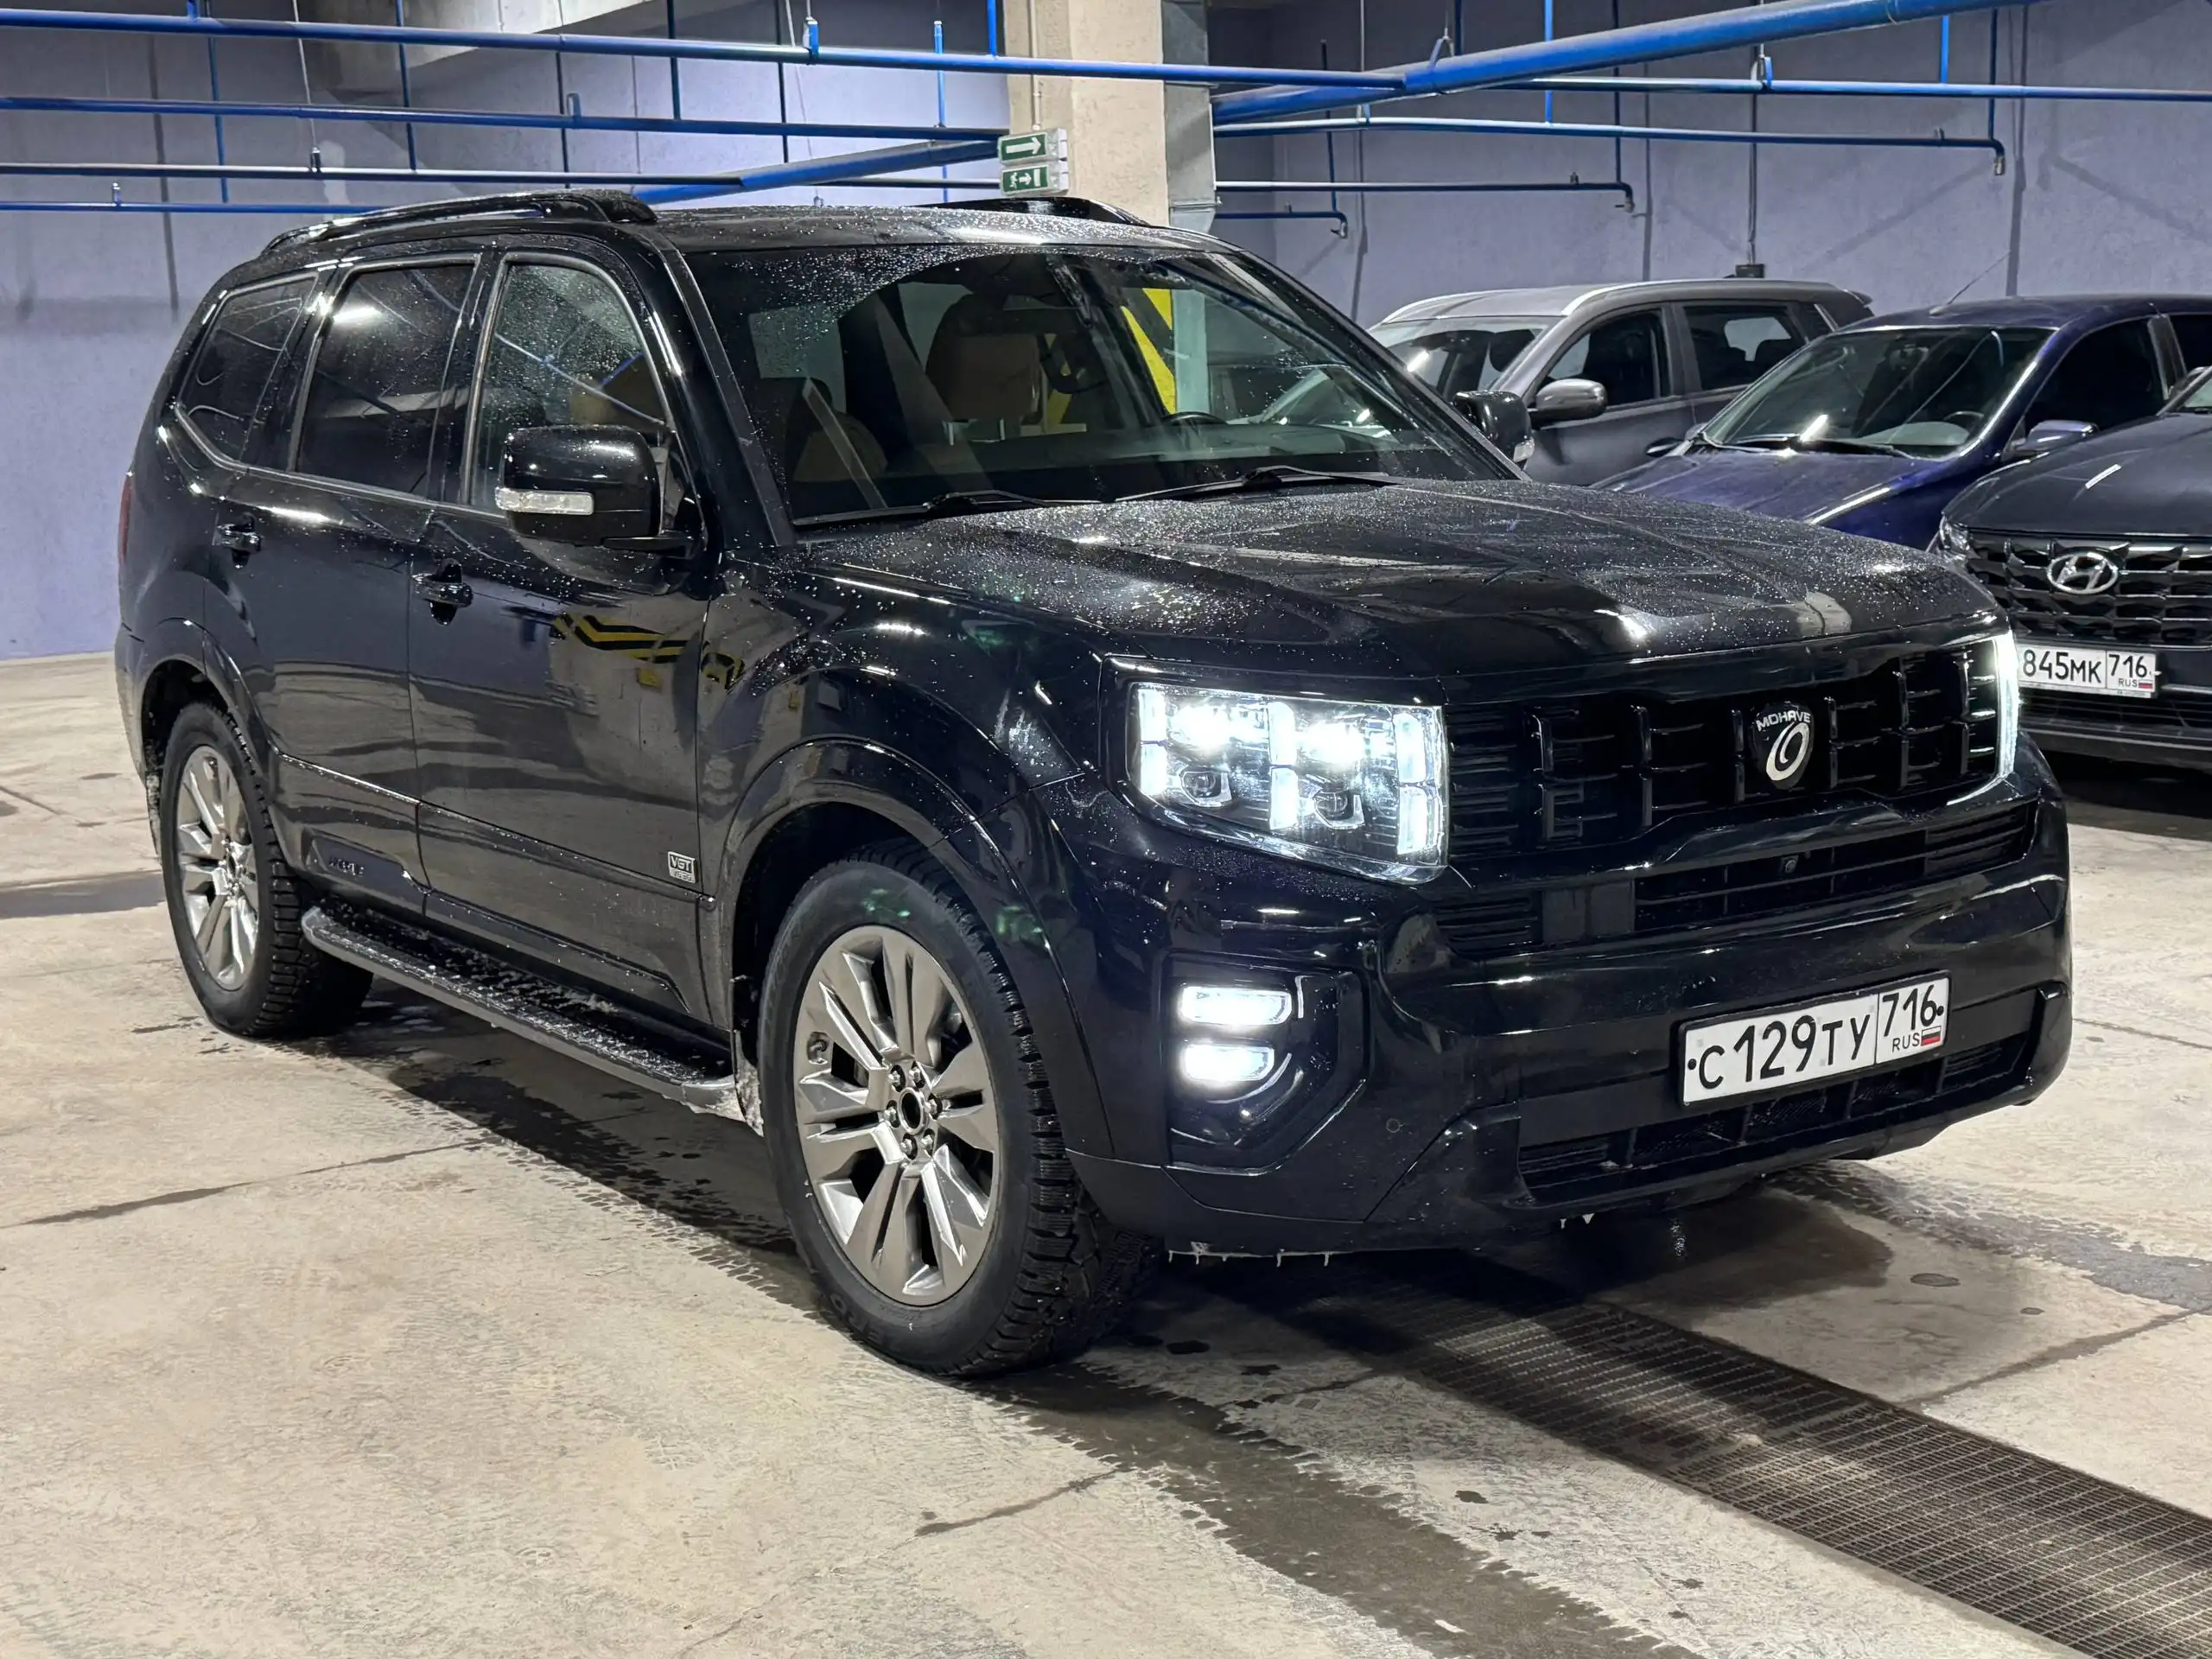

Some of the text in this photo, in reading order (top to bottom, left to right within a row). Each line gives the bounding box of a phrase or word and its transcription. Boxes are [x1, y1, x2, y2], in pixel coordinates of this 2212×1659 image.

[2023, 649, 2148, 683] 845МК 716
[2118, 678, 2138, 688] RUS
[1756, 709, 1811, 732] MOHAVE
[1699, 984, 1937, 1090] С129ТУ 716
[1892, 1033, 1920, 1052] RUS
